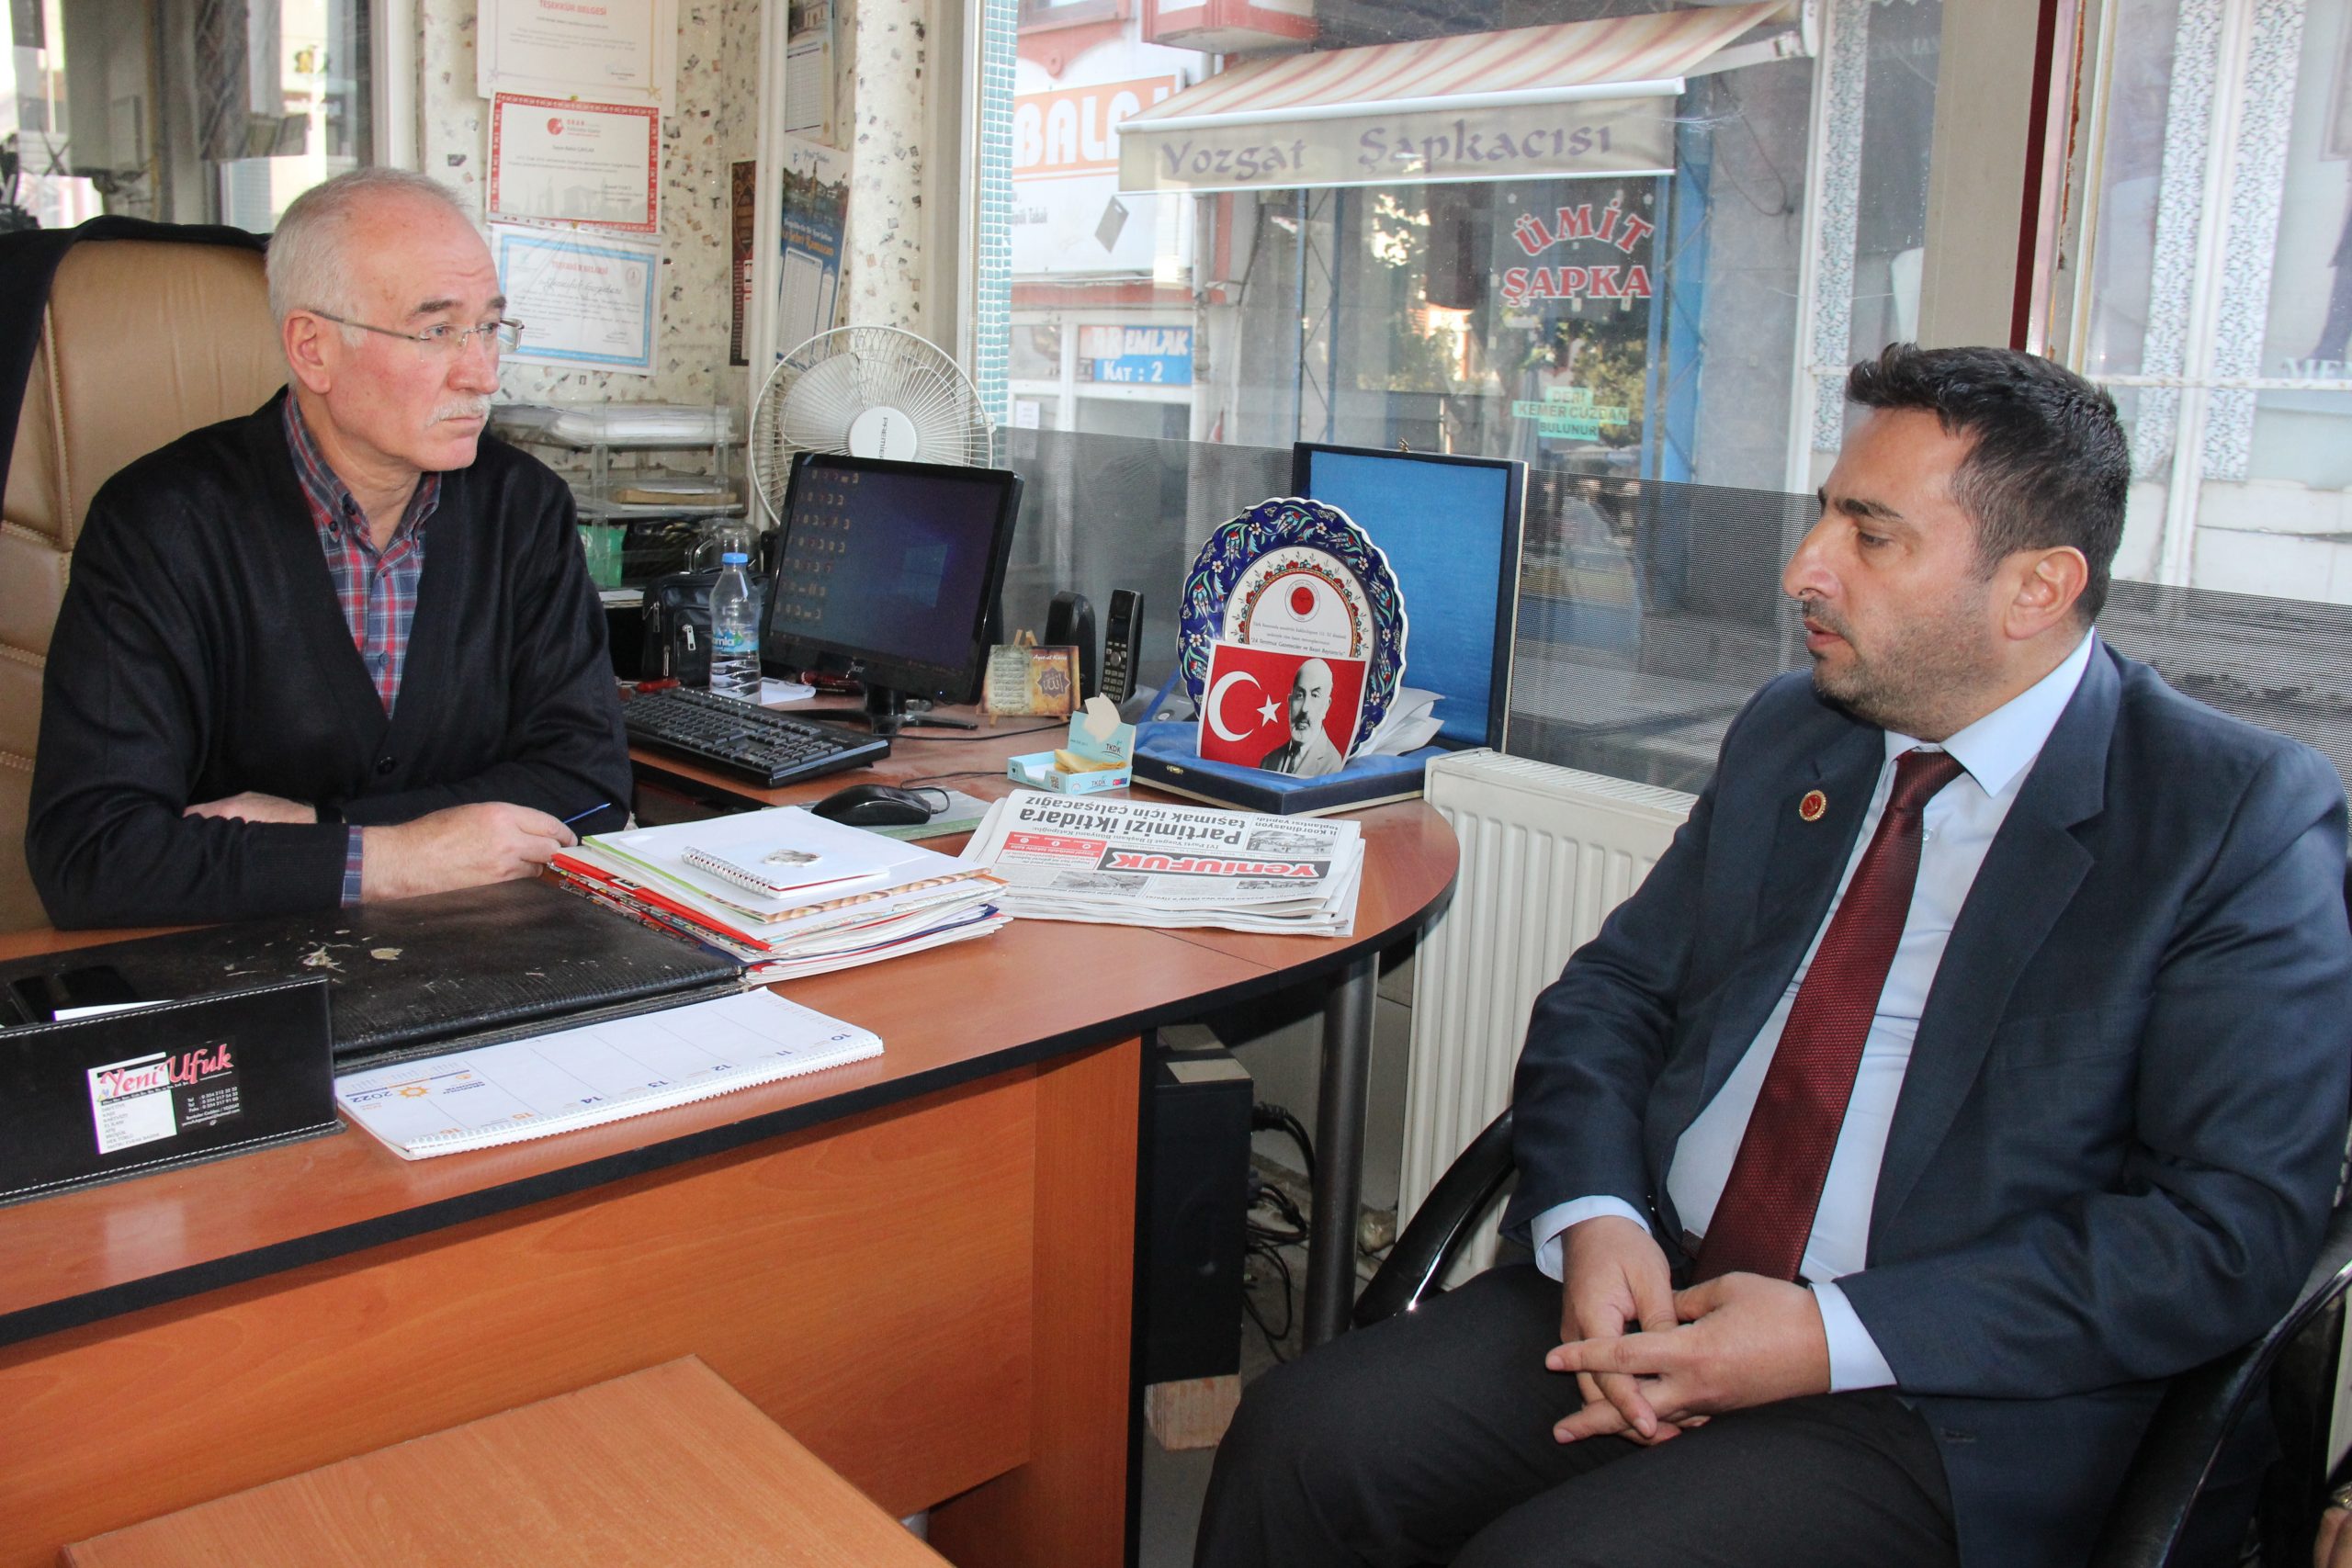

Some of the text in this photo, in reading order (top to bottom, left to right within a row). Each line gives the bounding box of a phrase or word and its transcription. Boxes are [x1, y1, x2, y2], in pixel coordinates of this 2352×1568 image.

[1161, 119, 1611, 181] Yozgat Şapkacısı
[1512, 197, 1655, 256] ÜMİT
[1500, 265, 1652, 308] ŞAPKA
[1124, 328, 1188, 355] EMLAK
[1151, 361, 1163, 382] 2
[1518, 403, 1566, 418] KEMER
[1540, 422, 1598, 436] BULUNUR
[1105, 742, 1121, 753] TKDK
[1024, 796, 1129, 816] çalışacağız
[1133, 807, 1167, 821] için
[1170, 812, 1246, 829] taşımak
[1019, 808, 1242, 845] Partimizi iktidara
[1255, 822, 1327, 835] Koordinasyon
[831, 1032, 852, 1041] 10
[99, 1065, 165, 1098] Yeni
[165, 1043, 234, 1084] Ufuk
[648, 1080, 670, 1089] 13
[349, 1090, 393, 1103] 2022
[580, 1096, 604, 1104] 14
[512, 1111, 535, 1121] 15
